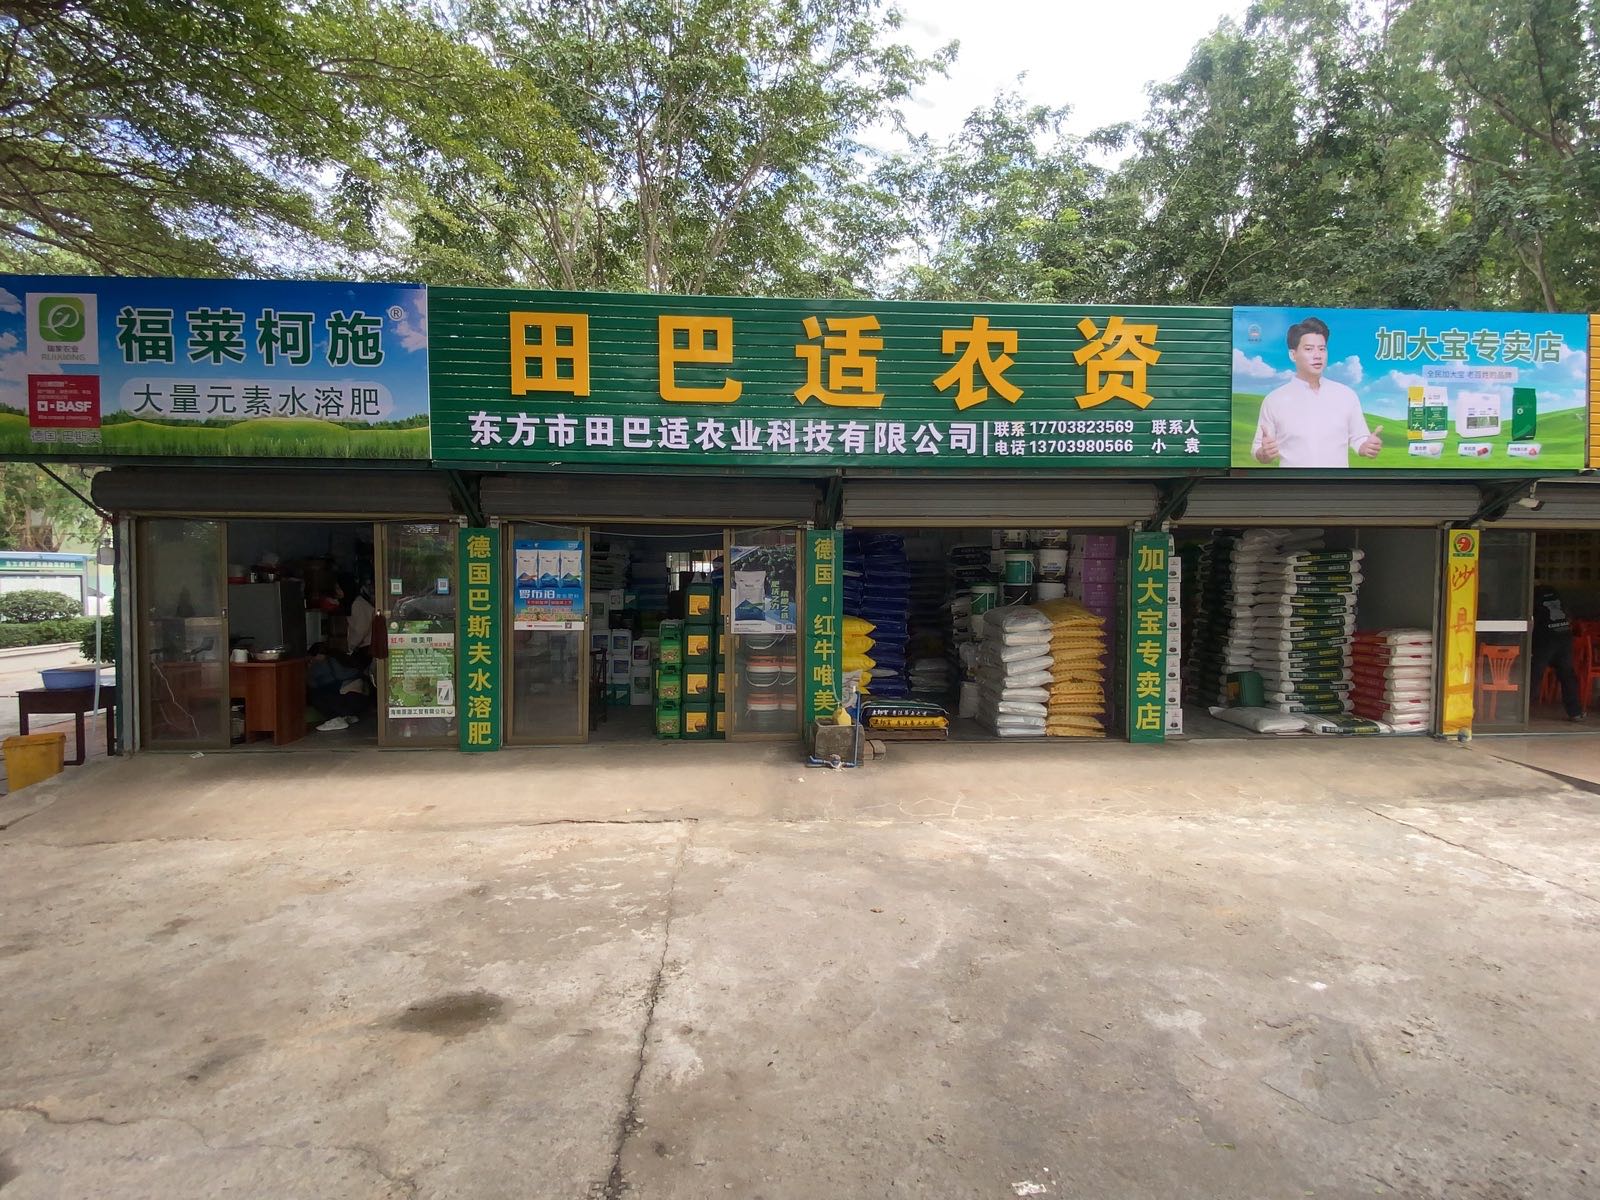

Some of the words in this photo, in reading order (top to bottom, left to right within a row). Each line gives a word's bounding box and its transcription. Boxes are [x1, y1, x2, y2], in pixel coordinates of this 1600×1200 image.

[116, 305, 385, 367] 福莱柯施
[1375, 326, 1565, 364] 加大宝专卖店
[509, 310, 1162, 412] 田巴适农资
[1426, 369, 1465, 379] 全民加大宝
[1467, 370, 1512, 380] 老百姓的品牌
[56, 400, 92, 412] BASF
[132, 383, 381, 417] 大量元素水溶肥
[468, 410, 977, 455] 东方市田巴适农业科技有限公司
[993, 420, 1026, 437] 联系
[1030, 420, 1134, 435] 17703823569
[1151, 419, 1200, 436] 联系人
[32, 430, 57, 443] 德国
[62, 429, 102, 445] 巴斯夫
[1151, 437, 1167, 454] 小
[1184, 437, 1200, 454] 袁
[994, 440, 1026, 455] 电话
[1029, 439, 1134, 454] 13703980566
[519, 589, 555, 599] 罗布泊
[466, 534, 492, 746] 德国巴斯夫水溶肥
[1136, 545, 1164, 731] 加大宝专卖店
